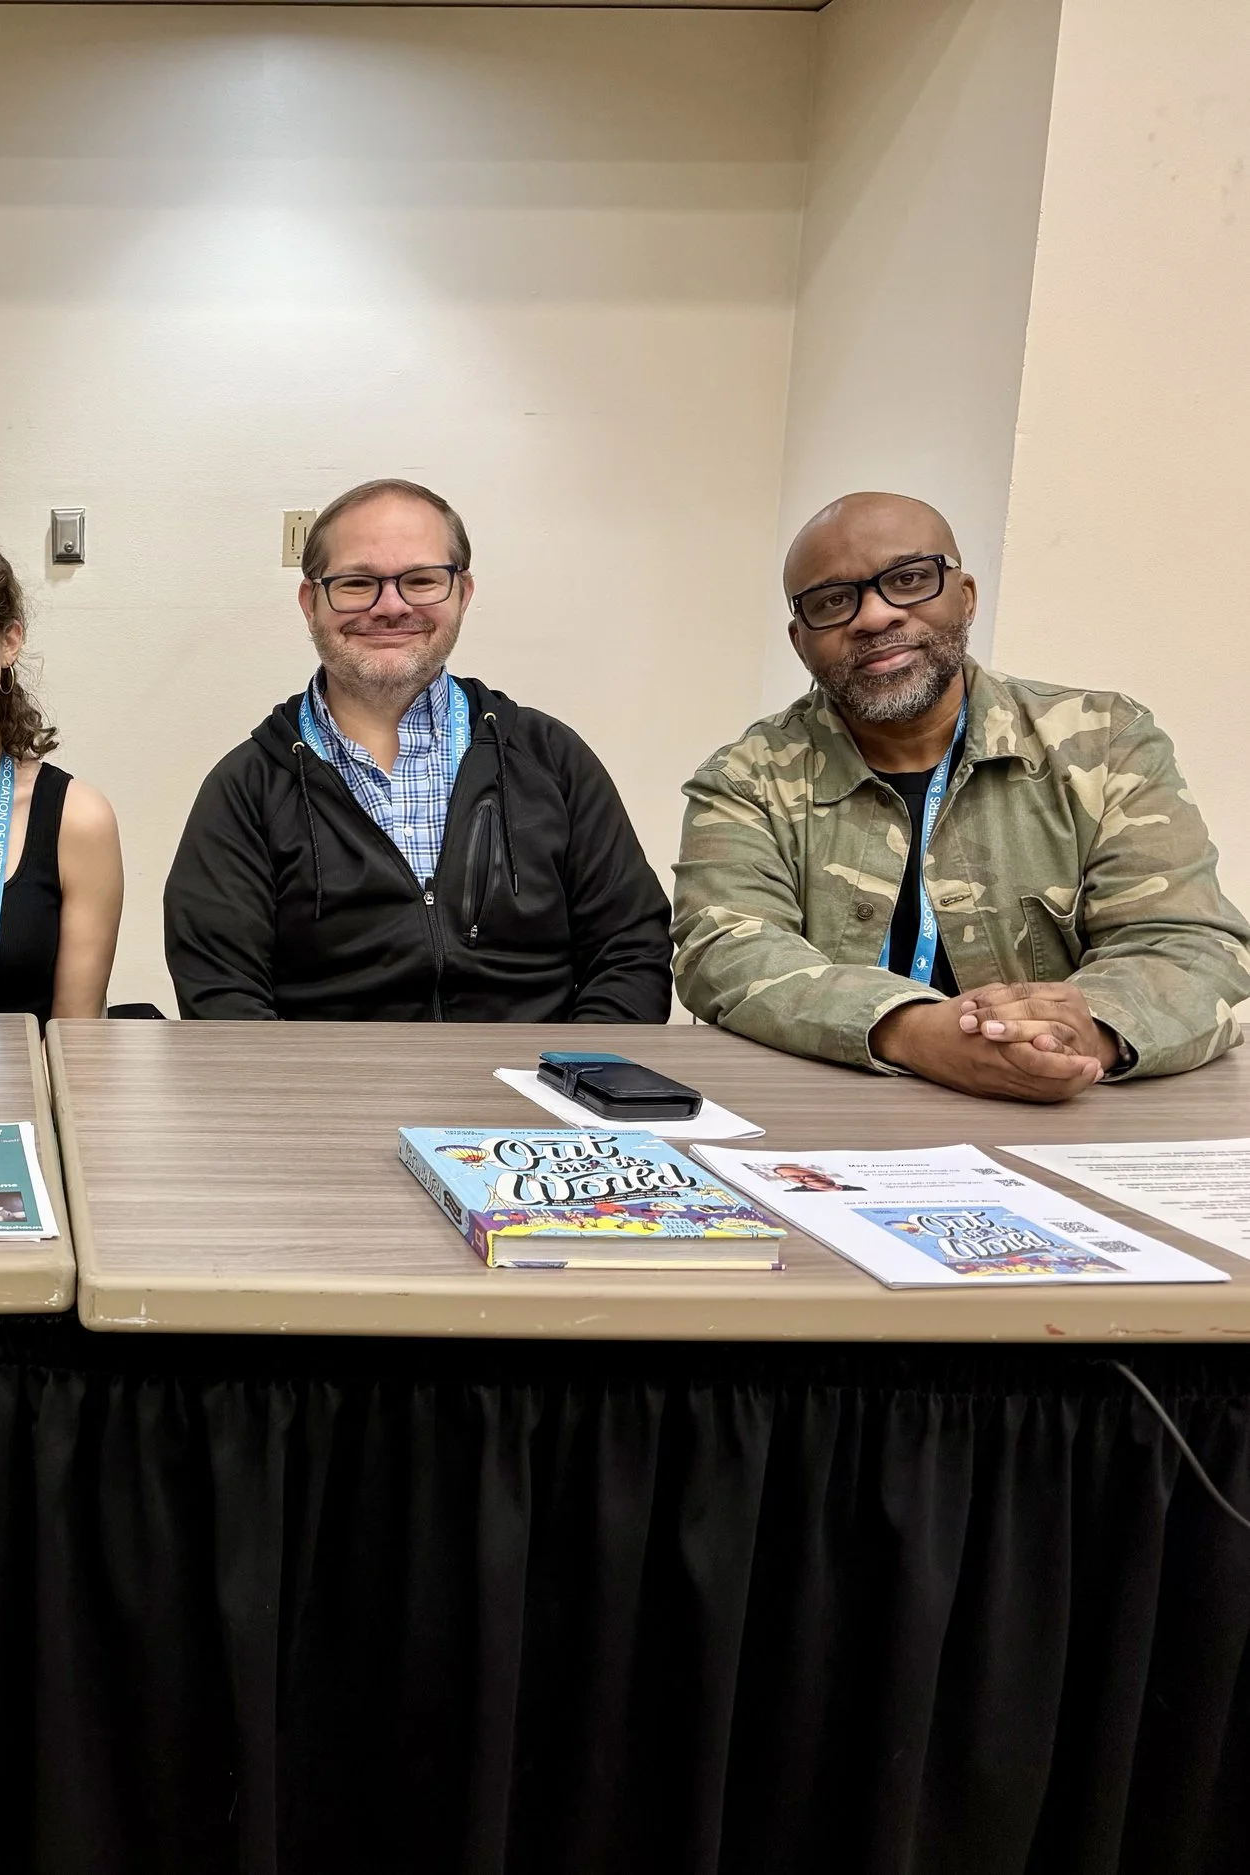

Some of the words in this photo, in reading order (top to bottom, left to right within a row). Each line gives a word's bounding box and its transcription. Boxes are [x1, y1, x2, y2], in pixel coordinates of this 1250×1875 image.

[455, 711, 465, 726] OF
[931, 784, 941, 794] &
[479, 1135, 618, 1171] Out
[549, 1161, 589, 1174] in
[610, 1155, 655, 1168] the
[496, 1163, 696, 1205] World
[907, 1210, 994, 1237] Out
[937, 1230, 1054, 1259] World
